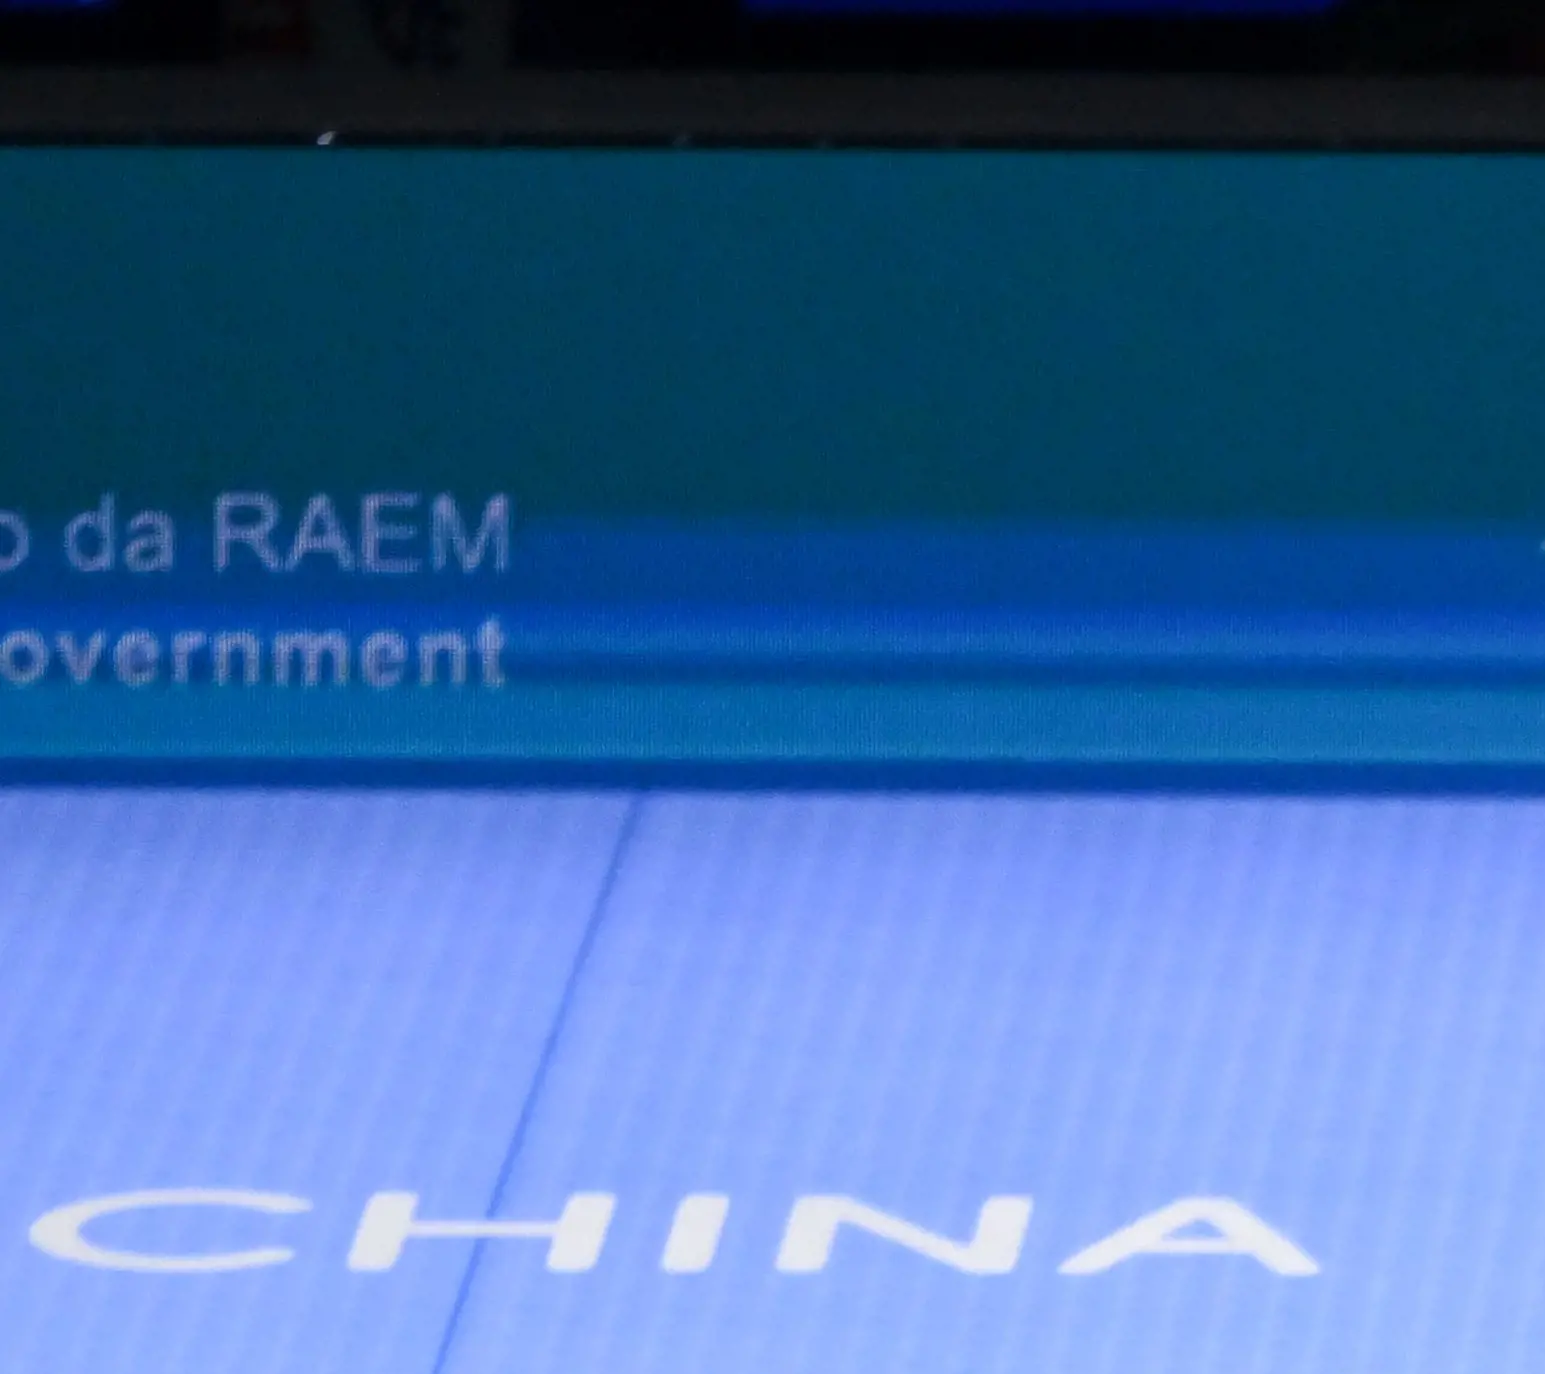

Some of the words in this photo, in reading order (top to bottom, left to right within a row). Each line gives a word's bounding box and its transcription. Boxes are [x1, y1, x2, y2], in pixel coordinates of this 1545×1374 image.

[64, 493, 175, 573] da
[213, 492, 512, 573] RAEM
[30, 1188, 1321, 1276] CHINA
